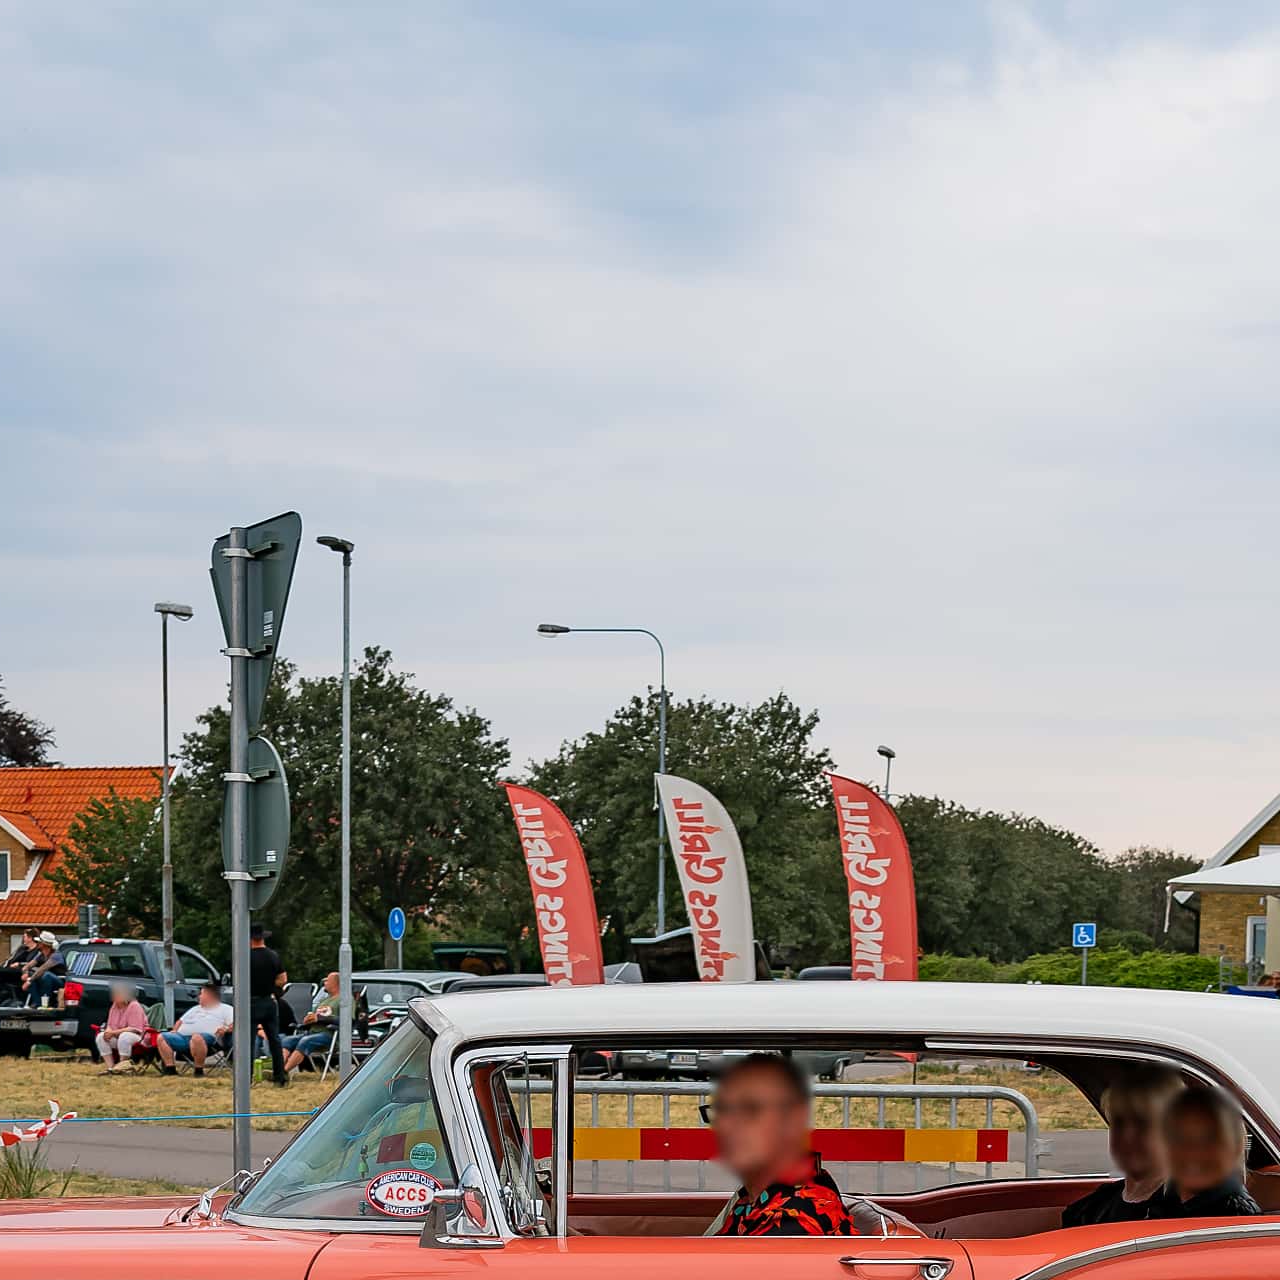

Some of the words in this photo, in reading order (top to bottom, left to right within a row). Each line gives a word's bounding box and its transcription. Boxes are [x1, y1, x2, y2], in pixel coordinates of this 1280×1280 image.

[379, 1172, 408, 1185] AMERICAN
[408, 1173, 420, 1182] CAR
[420, 1175, 435, 1188] CLUB
[385, 1187, 427, 1202] ACCS
[383, 1204, 424, 1215] SWEDEN
